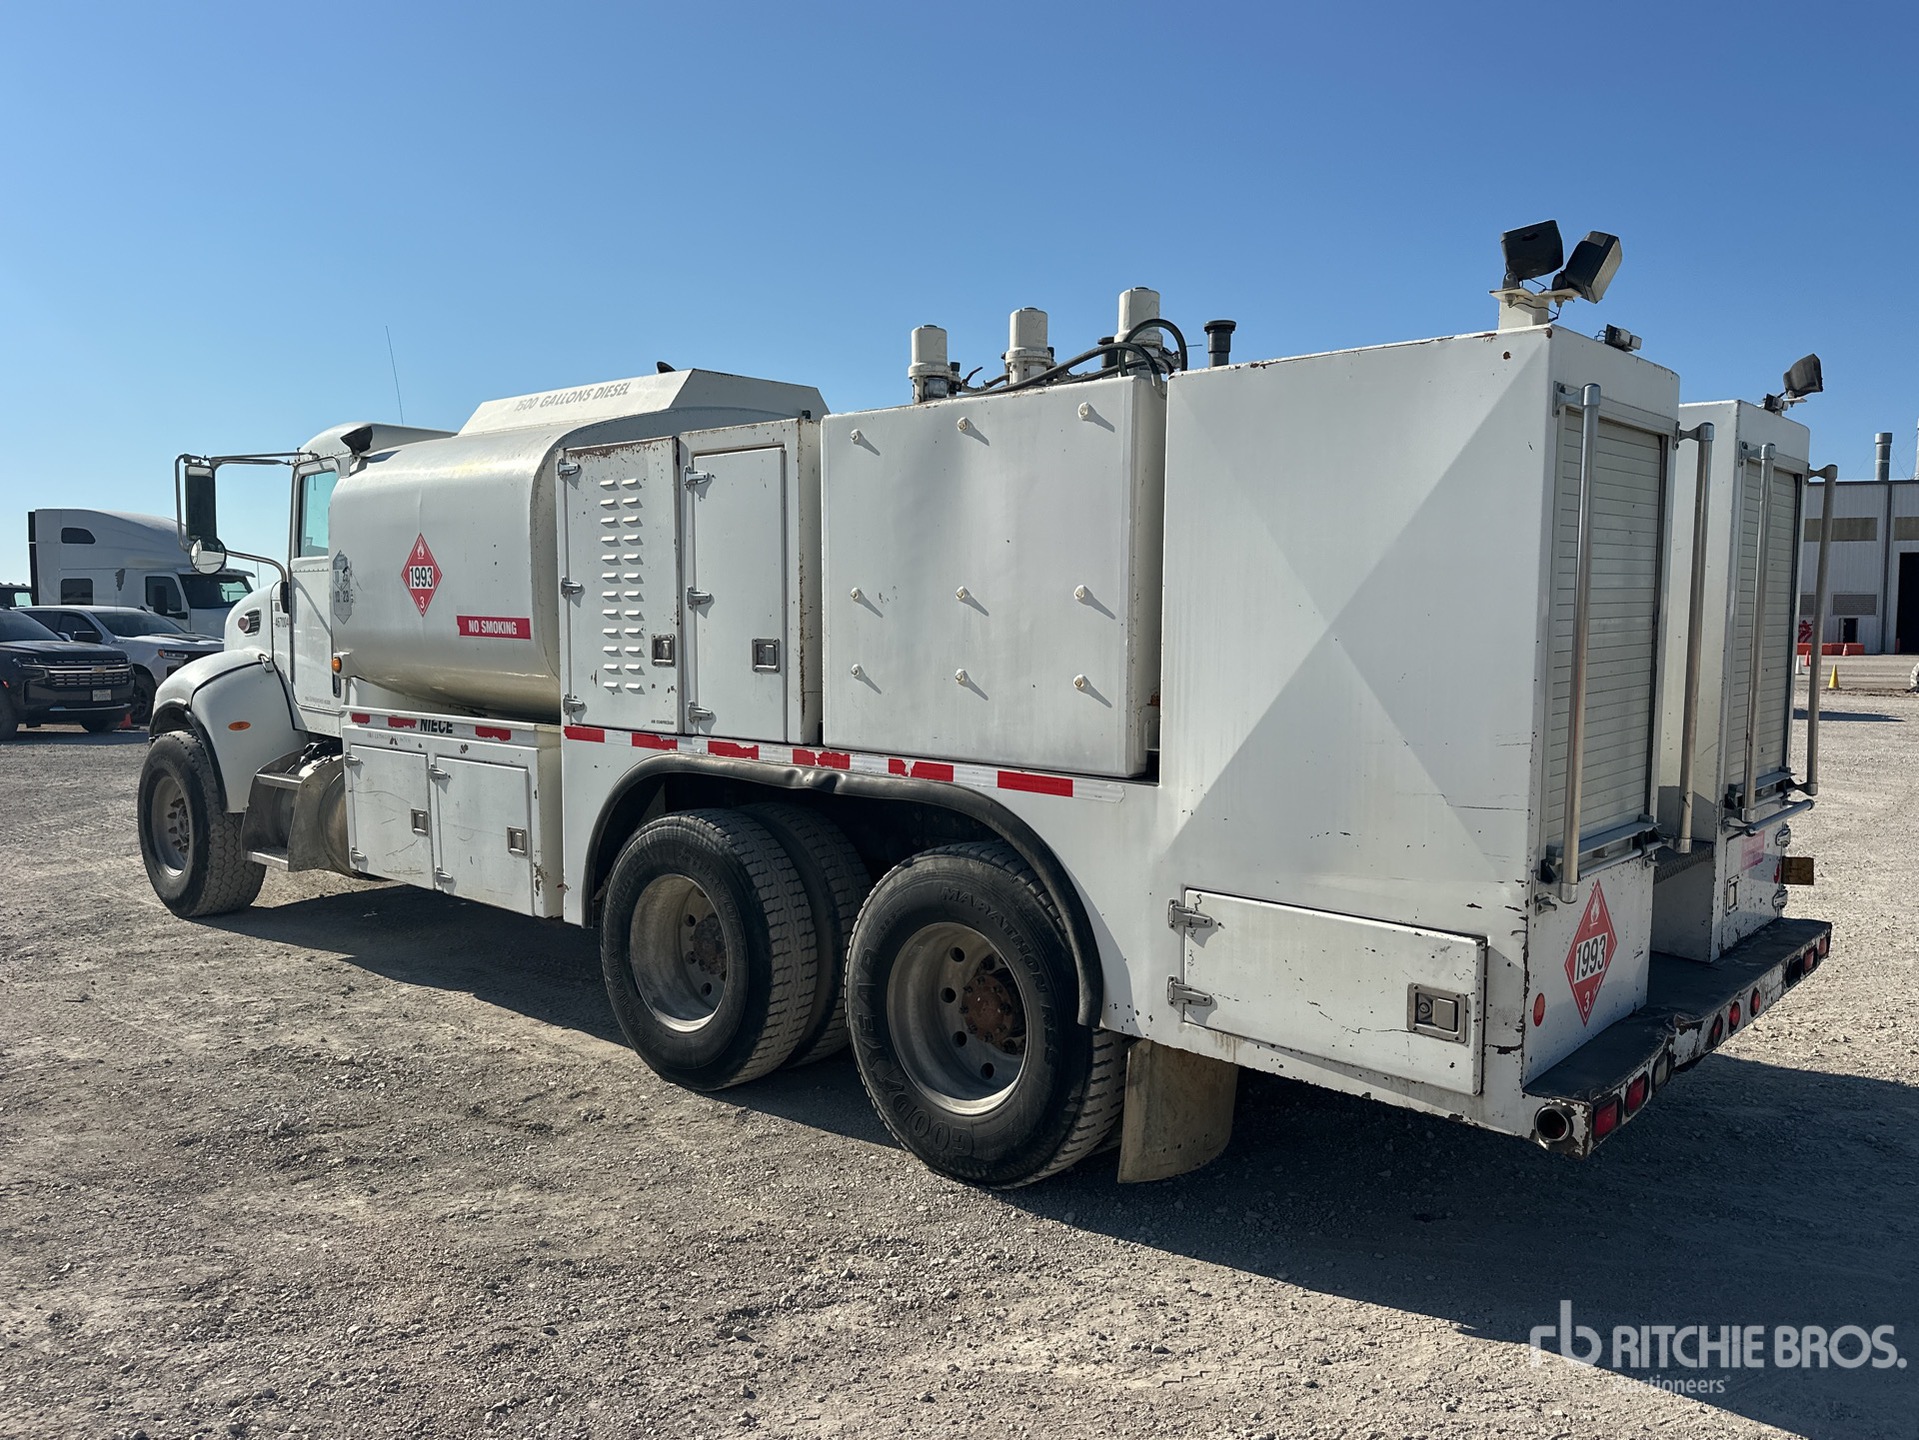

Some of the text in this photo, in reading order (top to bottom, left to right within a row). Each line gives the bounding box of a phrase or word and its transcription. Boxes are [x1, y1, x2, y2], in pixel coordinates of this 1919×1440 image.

[539, 388, 594, 408] GALLONS
[592, 382, 632, 400] DIESEL
[409, 567, 434, 588] 1993
[419, 596, 425, 609] 3
[468, 619, 518, 635] NO SMOKING
[420, 718, 453, 734] NIECE
[940, 886, 1048, 993] MARATHON
[1575, 934, 1607, 981] 1993
[1583, 990, 1591, 1013] 3
[857, 947, 974, 1156] GOODYEAR
